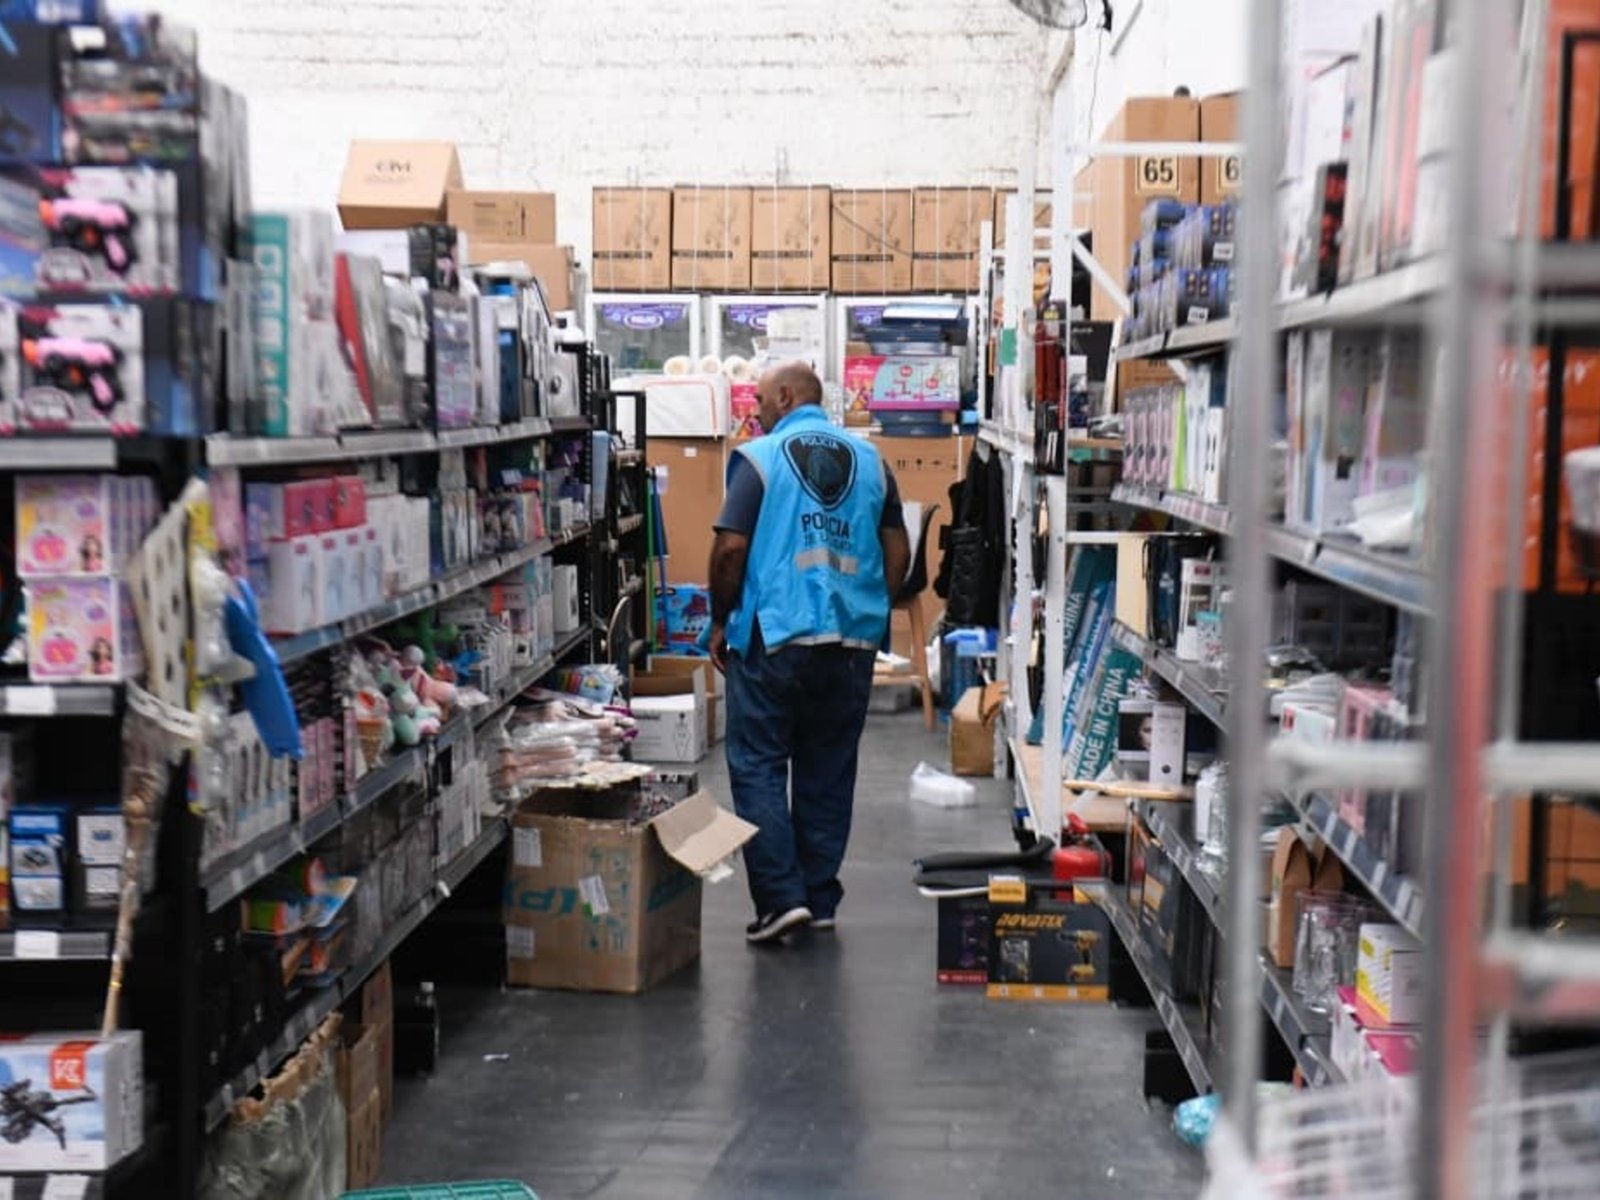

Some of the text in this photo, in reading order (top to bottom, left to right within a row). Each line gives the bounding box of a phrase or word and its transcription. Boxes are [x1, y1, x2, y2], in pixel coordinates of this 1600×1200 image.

[1144, 157, 1173, 183] 65
[1225, 156, 1239, 181] 6
[1097, 666, 1126, 716] CHINA
[1092, 718, 1109, 736] IN
[1077, 737, 1105, 780] MADE
